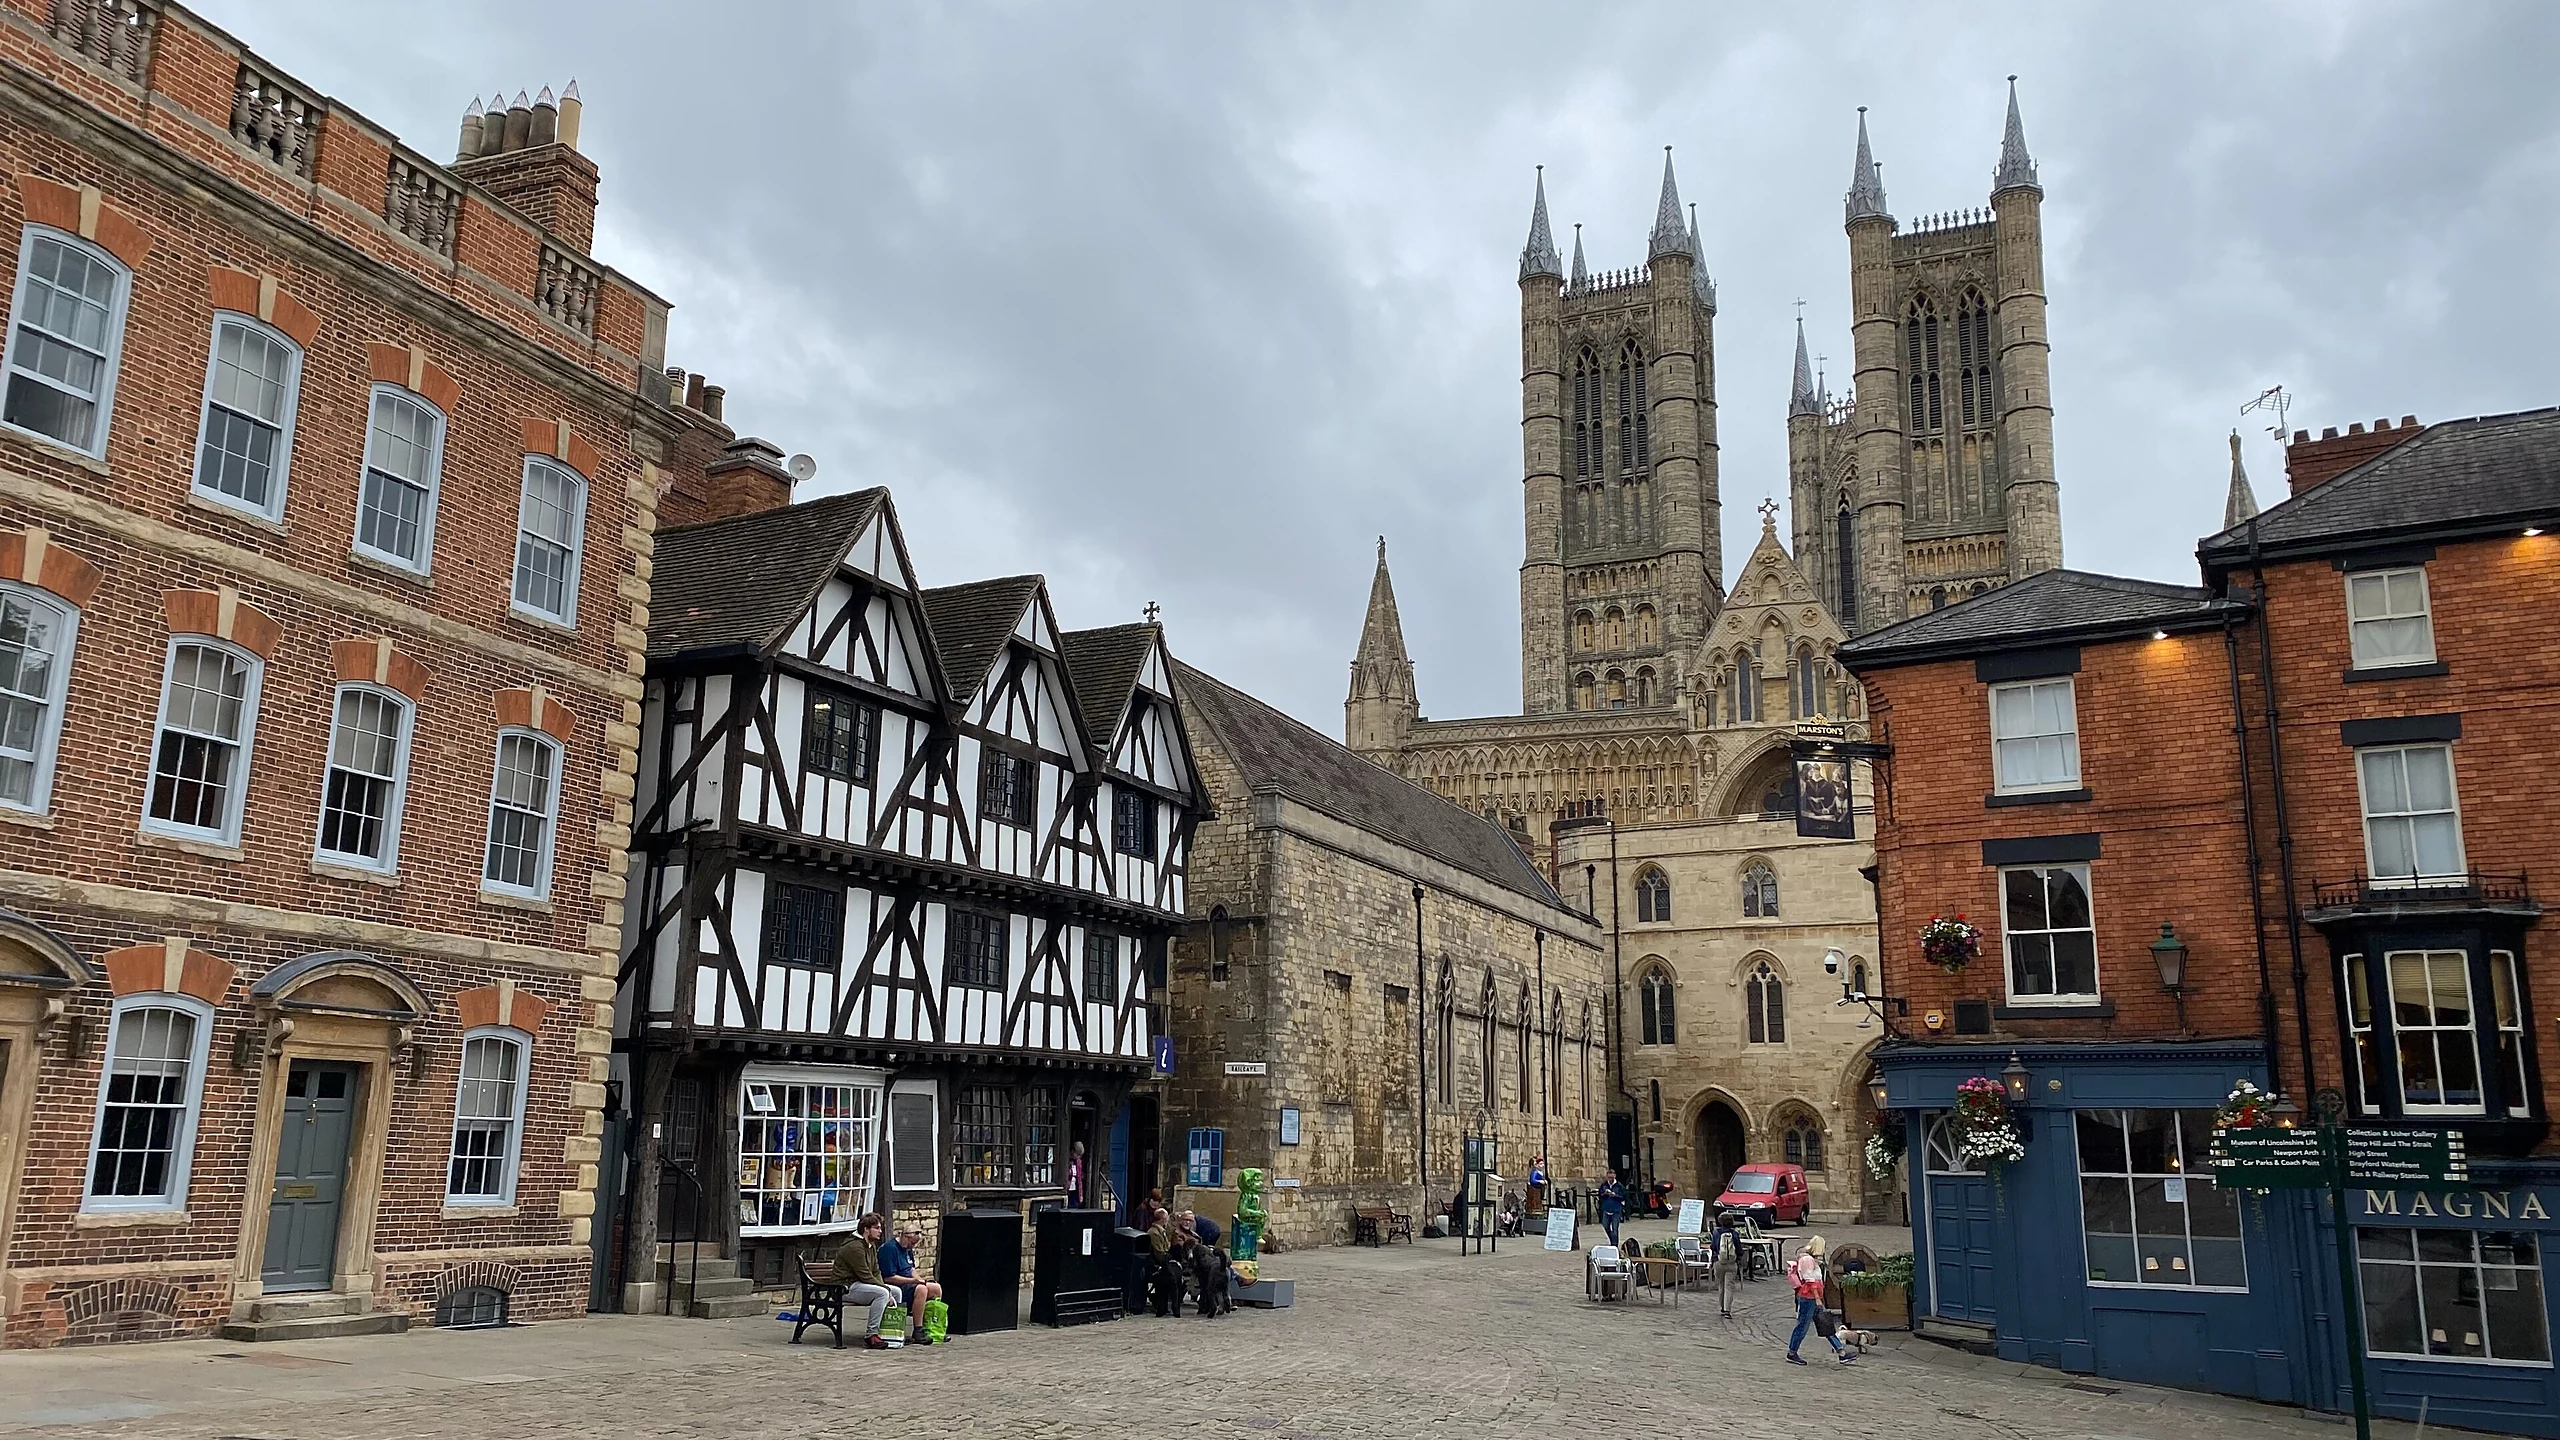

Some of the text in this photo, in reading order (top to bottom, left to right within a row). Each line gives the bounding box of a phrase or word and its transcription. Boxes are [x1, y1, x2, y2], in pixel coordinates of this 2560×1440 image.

[1798, 725, 1844, 735] MARSTON'S
[2290, 1129, 2317, 1137] Bailgate
[2346, 1129, 2381, 1137] Collection
[2411, 1130, 2438, 1139] Gallery
[2259, 1138, 2266, 1146] of
[2347, 1139, 2368, 1147] Steep
[2273, 1149, 2303, 1157] Newport
[2348, 1150, 2365, 1158] High
[2302, 1159, 2320, 1167] Point
[2349, 1160, 2420, 1169] Brayford Waterfront
[2372, 1171, 2399, 1180] Railway
[2363, 1189, 2551, 1220] MAGNA
